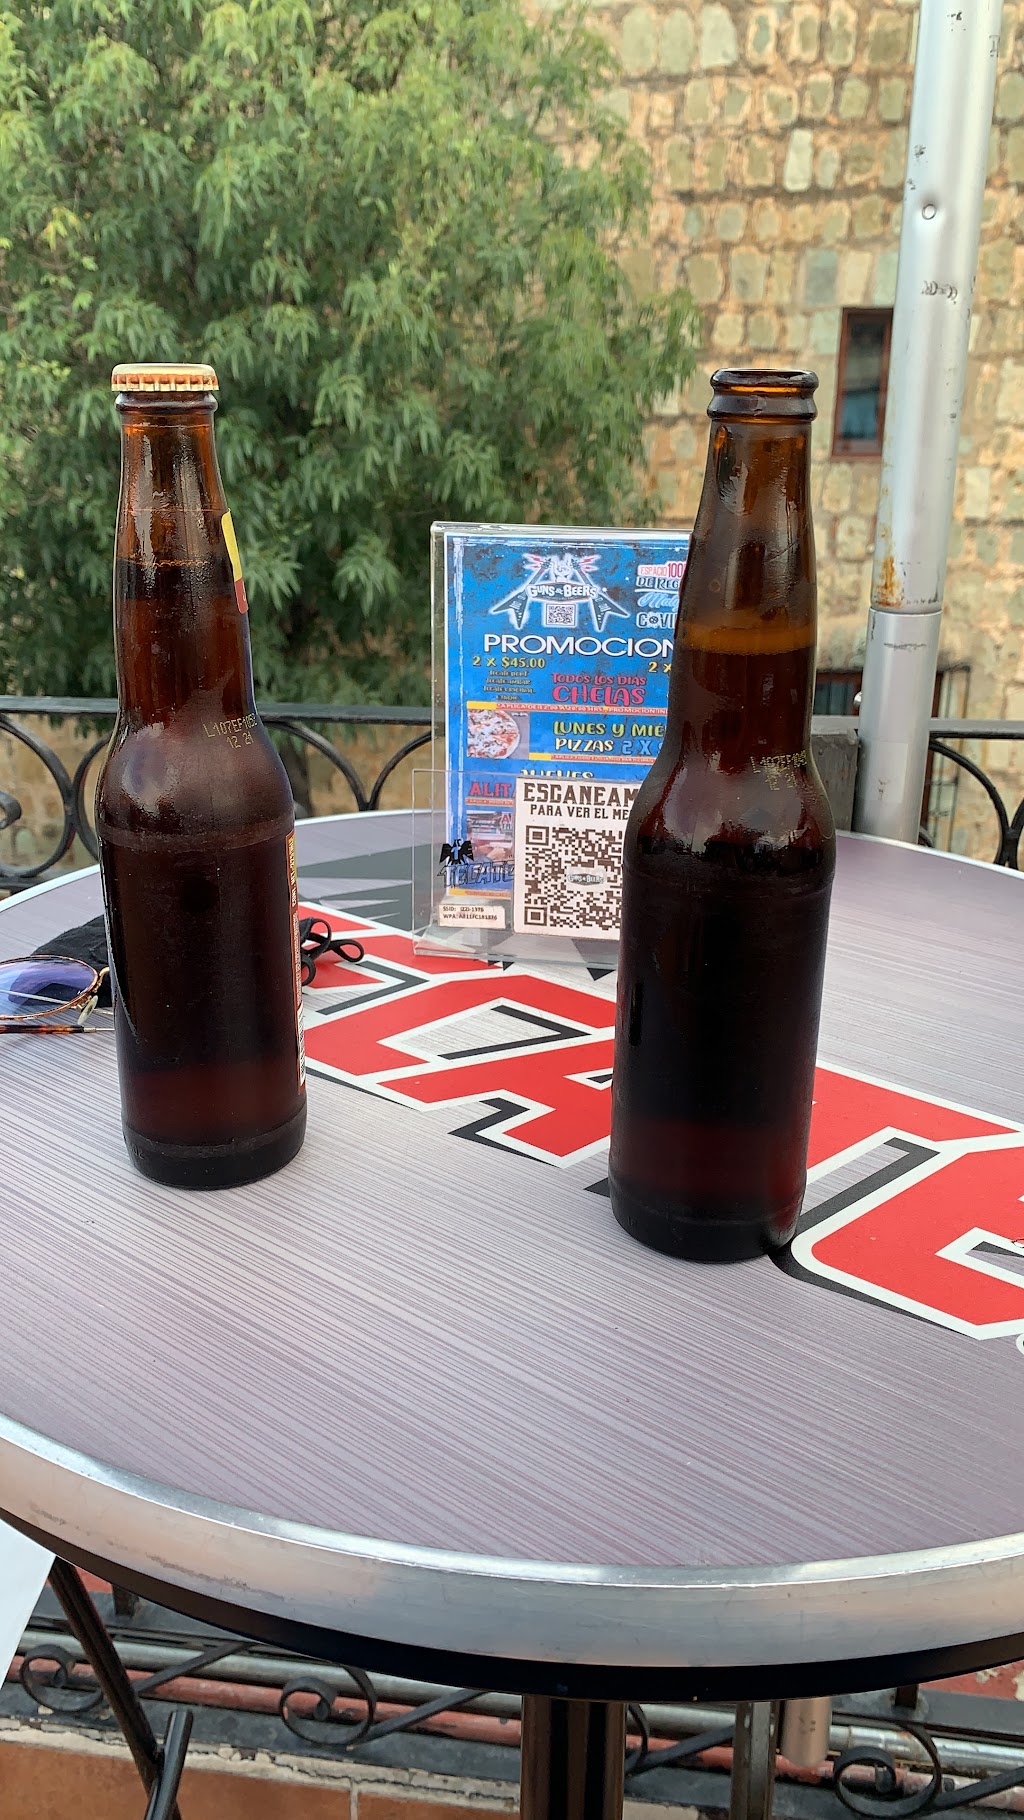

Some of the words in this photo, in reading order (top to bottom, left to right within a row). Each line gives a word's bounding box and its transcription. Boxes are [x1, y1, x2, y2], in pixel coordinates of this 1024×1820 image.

[640, 566, 668, 576] ESPACIO
[637, 577, 654, 588] DE
[527, 585, 555, 598] GUNS
[562, 584, 598, 598] BEERS
[483, 634, 675, 657] PROMOCION
[472, 655, 482, 667] 2
[501, 655, 546, 669] $45.00
[648, 661, 658, 673] 2
[552, 671, 591, 685] TODOS
[594, 675, 614, 686] LOS
[552, 684, 647, 707] CHELAS
[552, 720, 607, 737] LUNES
[631, 721, 667, 738] MIÉ
[554, 737, 615, 754] PIZZAS
[621, 740, 633, 756] 2
[639, 740, 652, 757] X
[530, 804, 563, 817] PARA
[567, 806, 591, 819] VER
[594, 807, 609, 819] EL
